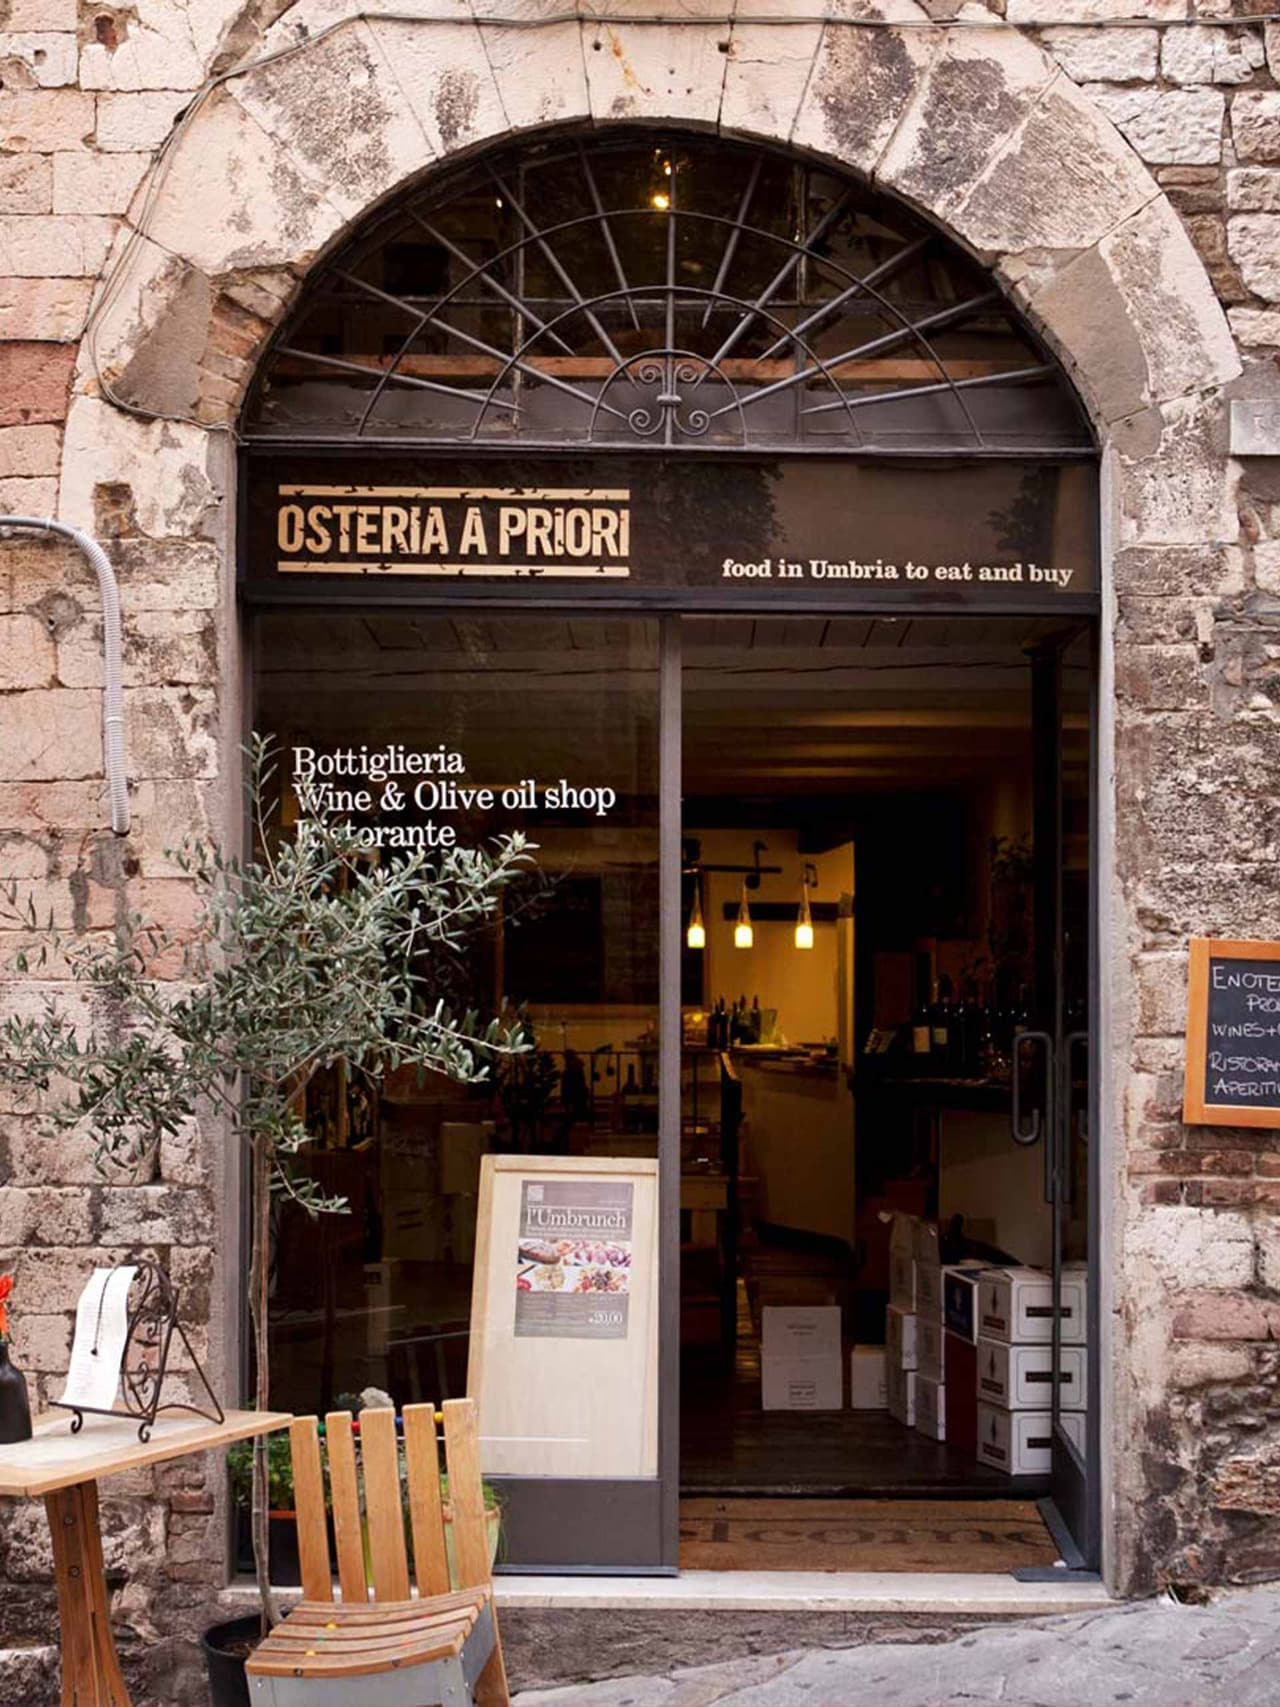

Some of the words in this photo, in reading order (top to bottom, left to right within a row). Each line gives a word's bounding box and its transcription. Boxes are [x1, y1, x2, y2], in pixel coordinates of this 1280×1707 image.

[278, 504, 449, 554] OSTERIA
[459, 508, 488, 555] A
[499, 508, 630, 557] PRIORI
[722, 559, 773, 578] food
[778, 559, 804, 578] in
[808, 560, 900, 579] Umbria
[905, 562, 929, 580] to
[934, 562, 973, 580] eat
[978, 563, 1023, 582] and
[1028, 565, 1074, 586] buy
[292, 745, 465, 781] Bottiglieria
[293, 782, 372, 811] Wine
[380, 781, 406, 811] &
[414, 781, 494, 811] Olive
[502, 780, 538, 809] oil
[544, 779, 616, 816] shop
[1212, 966, 1280, 991] ENOTE
[1246, 993, 1280, 1013] PRO
[526, 1207, 627, 1229] l'Umbrunch
